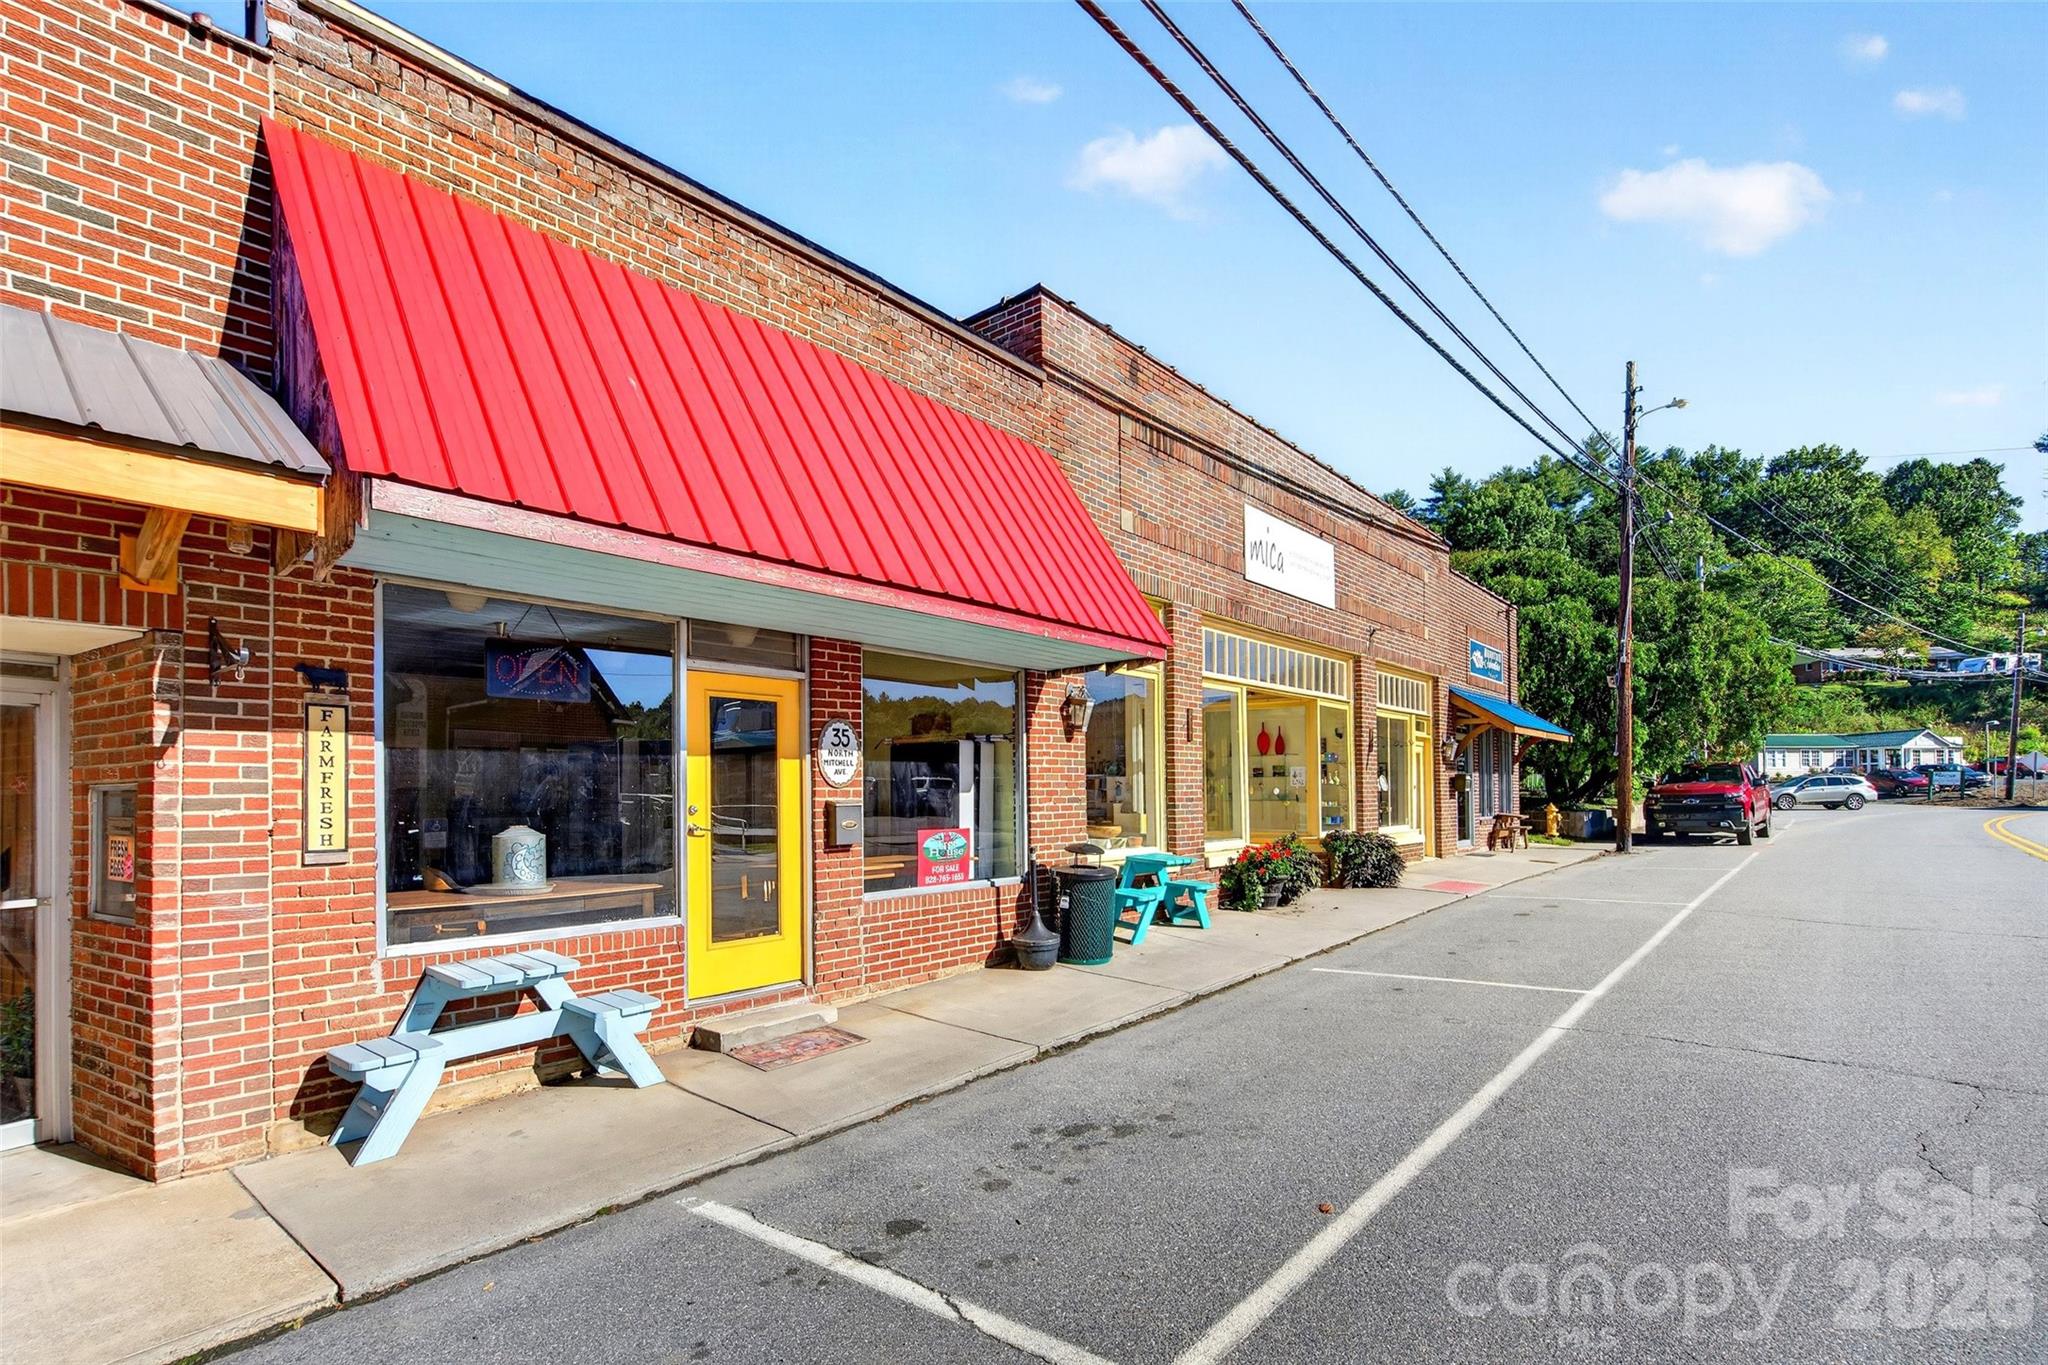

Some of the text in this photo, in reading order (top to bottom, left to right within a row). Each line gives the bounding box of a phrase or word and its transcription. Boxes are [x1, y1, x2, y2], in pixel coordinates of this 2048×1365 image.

[1250, 526, 1284, 574] mica
[495, 654, 578, 687] OPEN
[830, 728, 850, 748] 35
[823, 759, 854, 767] MITCHELL
[827, 749, 854, 758] NORTH
[109, 839, 129, 859] FRESH
[932, 863, 960, 874] FOR SALE
